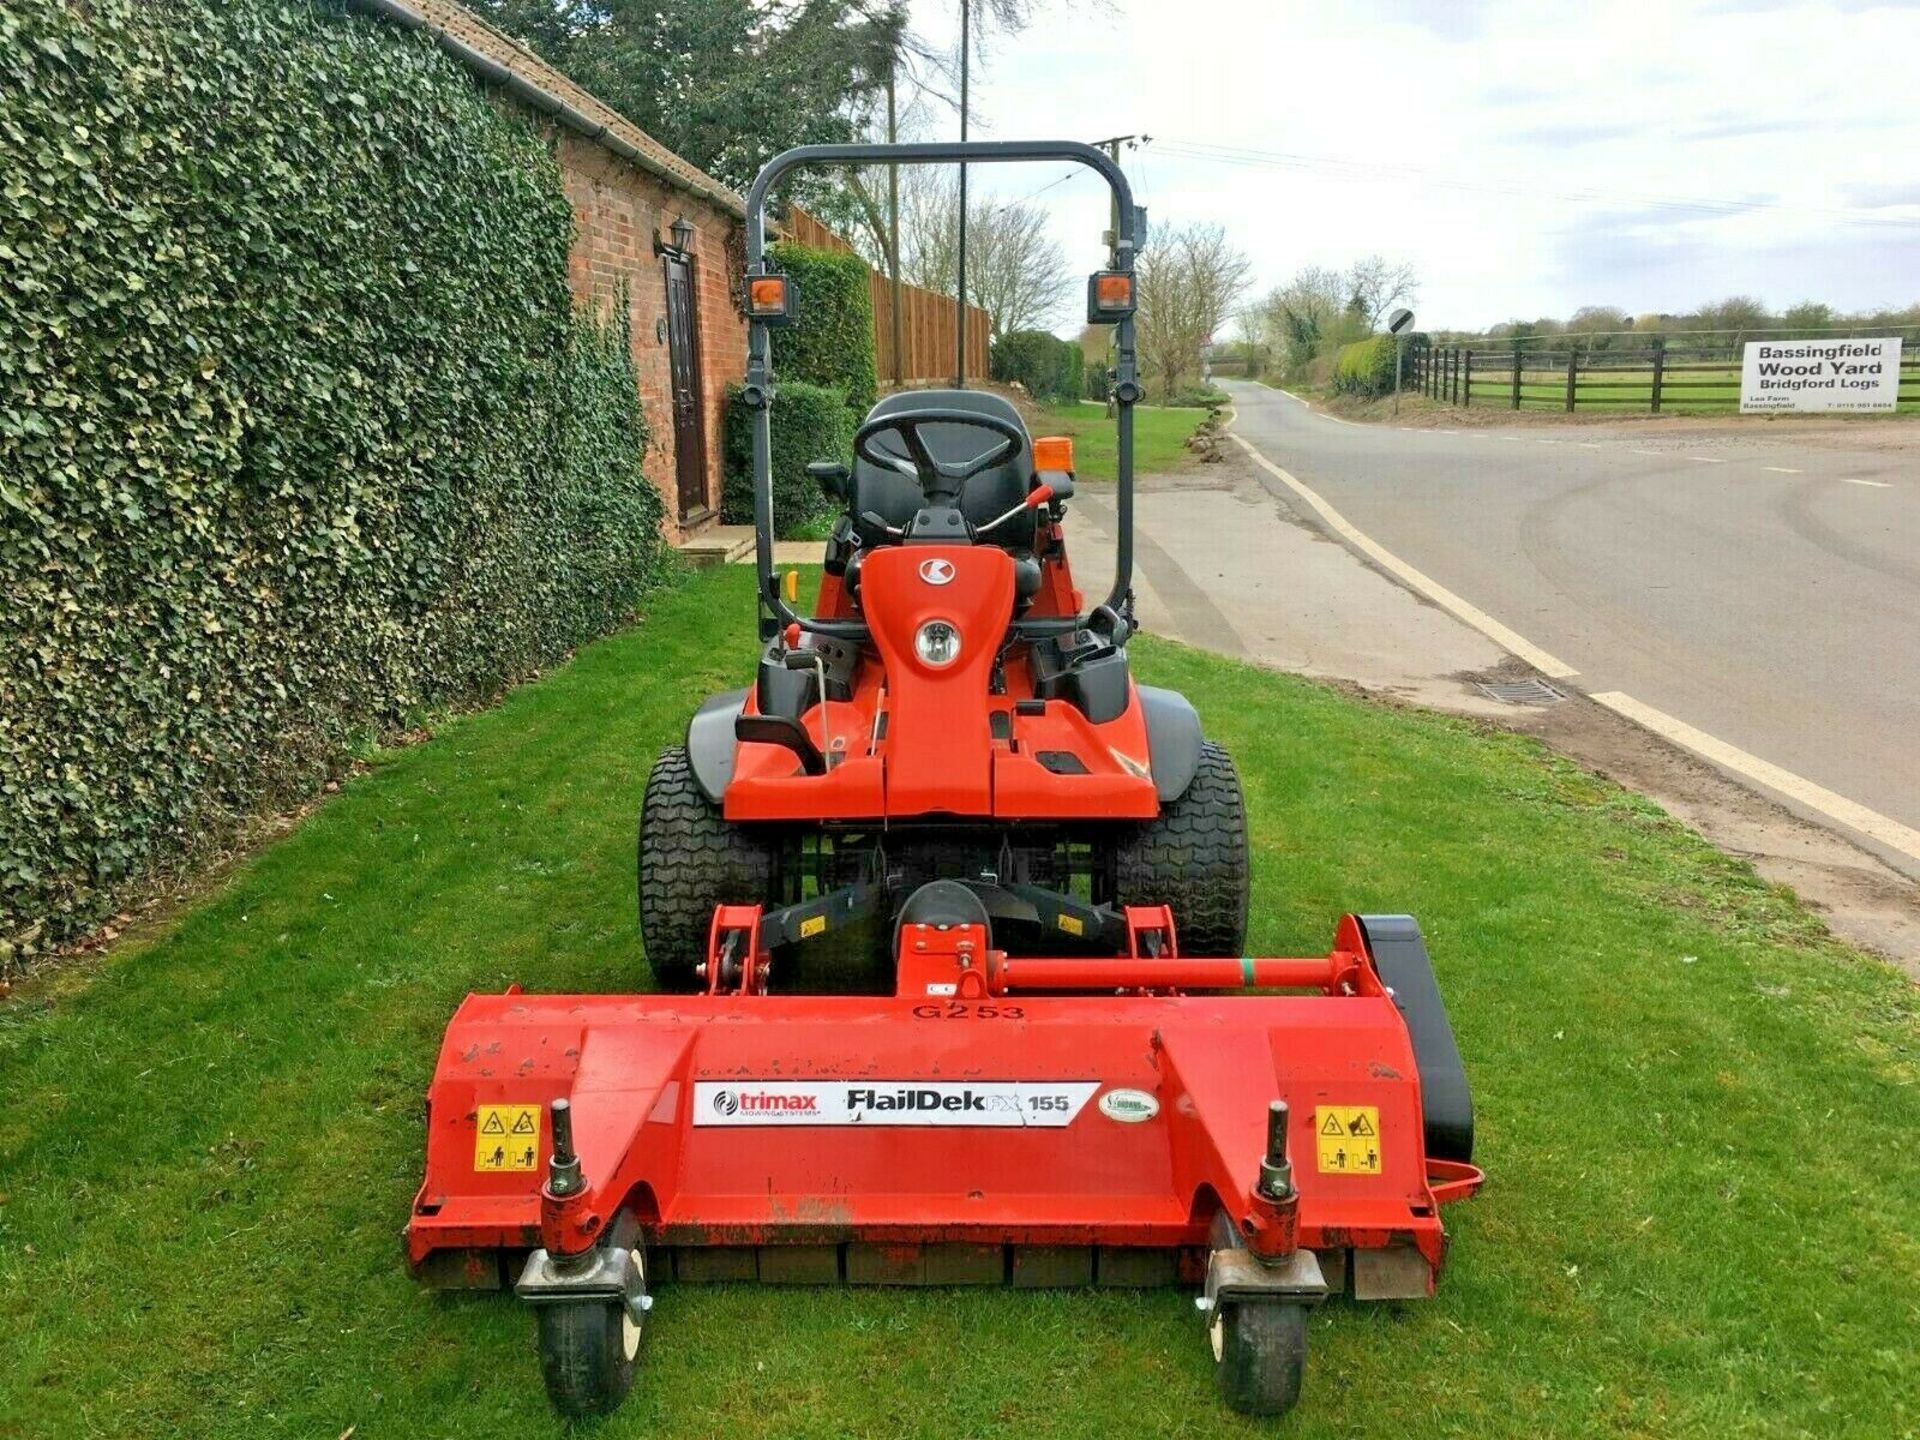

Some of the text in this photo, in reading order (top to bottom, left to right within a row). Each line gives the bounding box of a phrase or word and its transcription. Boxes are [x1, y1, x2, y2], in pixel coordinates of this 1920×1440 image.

[1759, 344, 1882, 360] Bassingfield
[1758, 361, 1882, 376] Wood Yard
[1760, 379, 1880, 390] Bridgford Logs
[912, 1004, 1025, 1019] G253
[739, 1091, 817, 1109] trimax
[1027, 1095, 1069, 1111] 155
